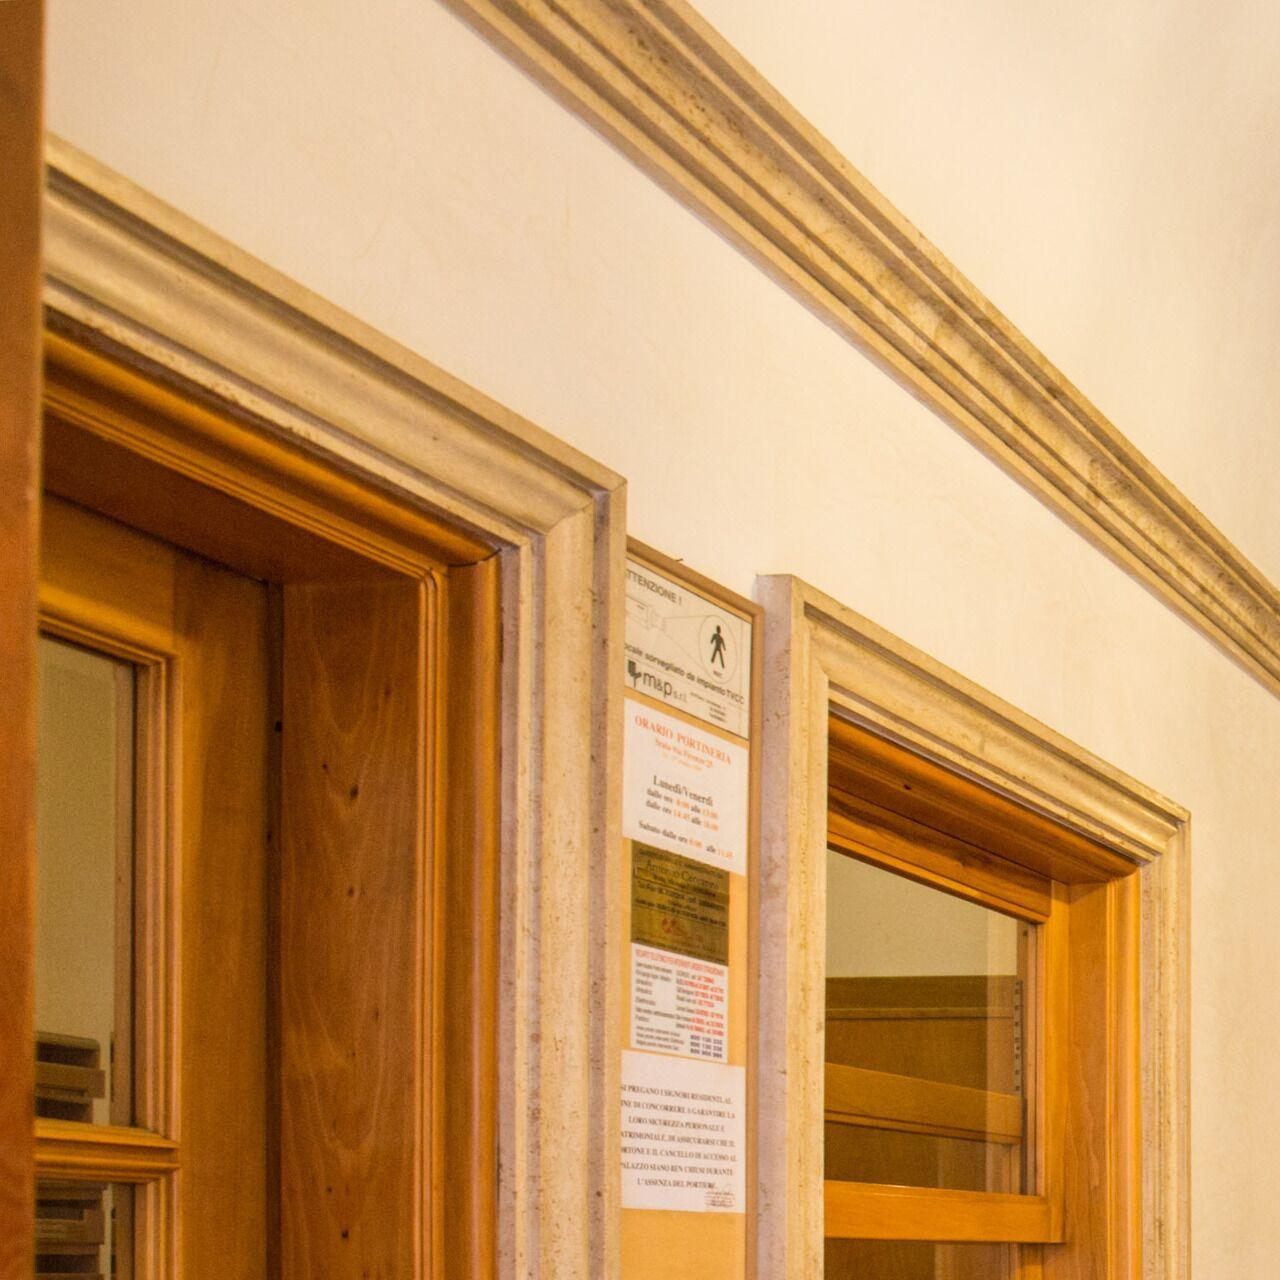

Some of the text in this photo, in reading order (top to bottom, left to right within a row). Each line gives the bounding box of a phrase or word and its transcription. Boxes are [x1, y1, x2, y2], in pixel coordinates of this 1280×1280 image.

[625, 569, 678, 603] TTENZIONE
[624, 643, 744, 704] ocale sorvegliato da impianto TVCC
[635, 715, 674, 741] ORARIO
[677, 732, 731, 764] PORTINERIA
[628, 1086, 659, 1095] PREGANO
[664, 1090, 690, 1099] SIGNORI
[642, 1103, 685, 1113] CONCORRERE
[691, 1108, 725, 1117] GARANTIRE
[628, 1116, 647, 1124] LORO
[648, 1118, 684, 1128] SICUREZZA
[685, 1122, 719, 1131] PERSONALE
[621, 1131, 667, 1142] ATRIMONIALE,
[677, 1136, 715, 1146] ASSICURARSI
[660, 1150, 693, 1158] CANCELLO
[703, 1153, 729, 1161] ACCESSO
[706, 1168, 733, 1176] DURANTE
